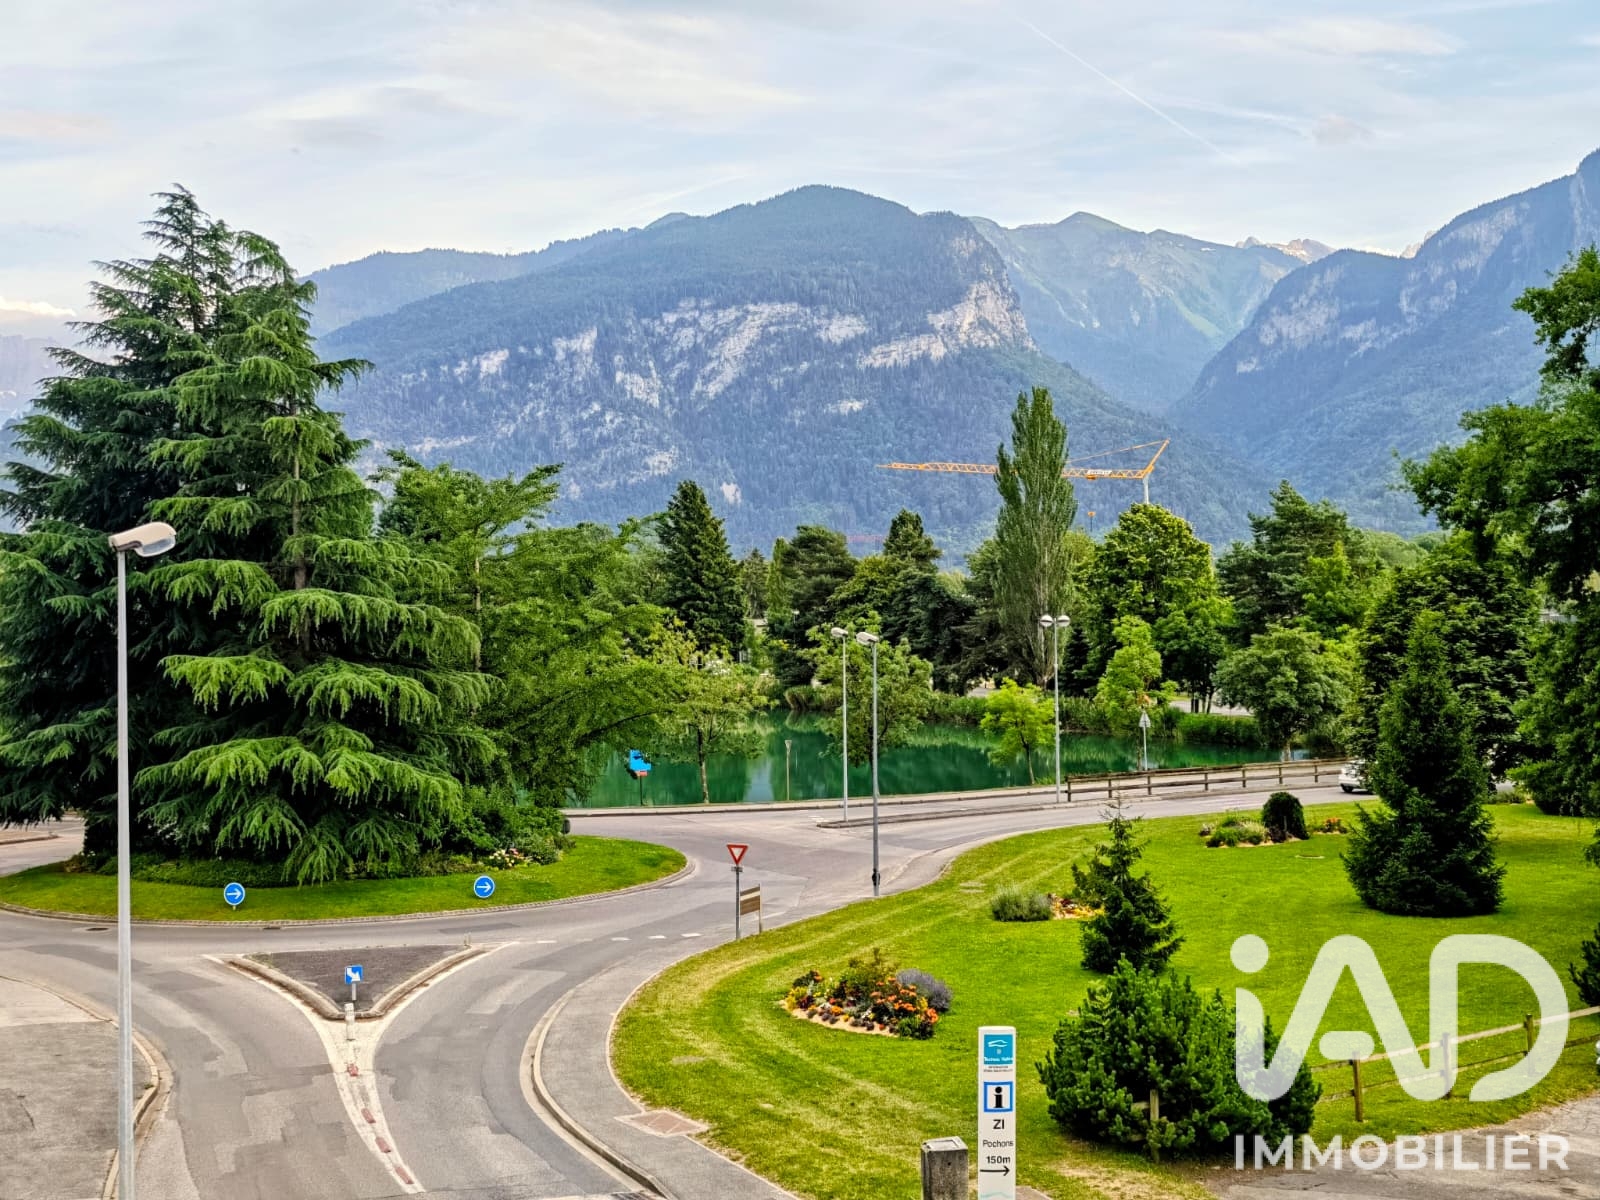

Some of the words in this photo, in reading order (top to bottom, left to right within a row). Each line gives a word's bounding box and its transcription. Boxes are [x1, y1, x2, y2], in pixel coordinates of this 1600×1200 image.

[993, 1119, 1004, 1129] ZI
[983, 1140, 1014, 1148] Pochons
[986, 1155, 1011, 1164] 150m
